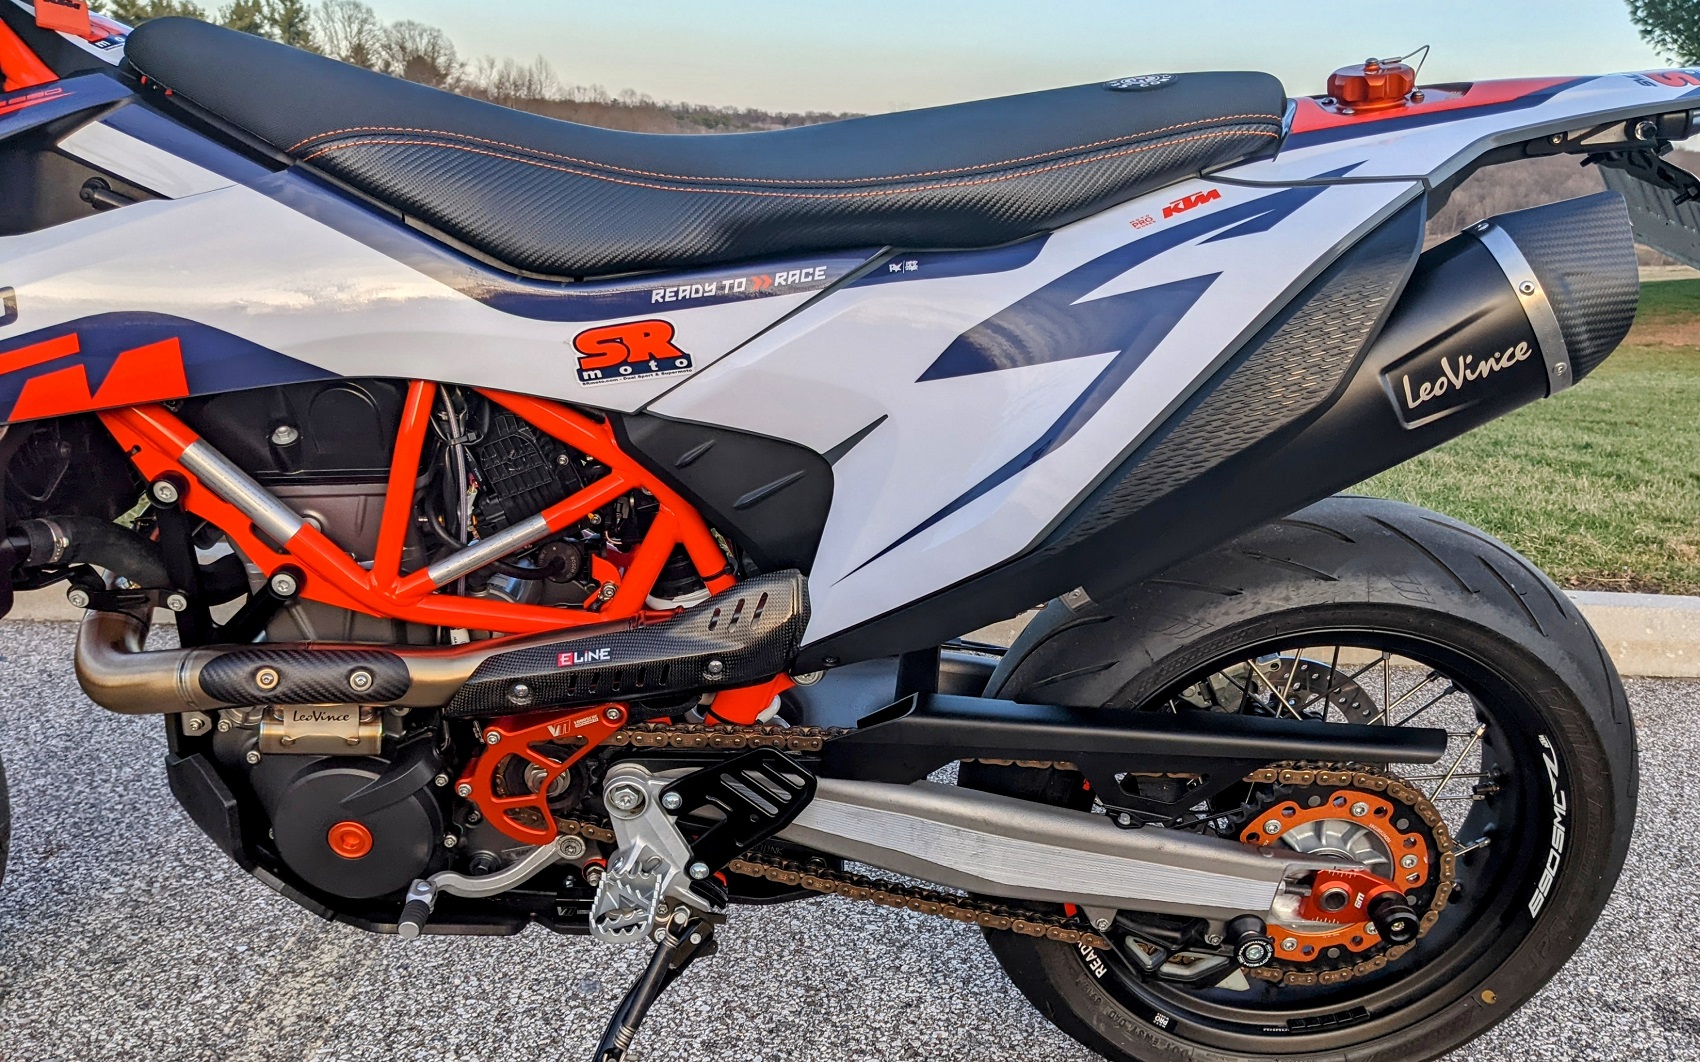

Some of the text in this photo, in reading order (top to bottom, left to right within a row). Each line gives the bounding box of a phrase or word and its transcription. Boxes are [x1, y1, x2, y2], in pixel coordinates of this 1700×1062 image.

[1162, 188, 1221, 219] KTM
[1132, 216, 1153, 228] PRO
[651, 265, 827, 304] READY TO RACE
[575, 320, 683, 370] SR
[583, 358, 688, 380] moto
[1403, 341, 1532, 409] LeoVince
[293, 710, 350, 722] LeoVince
